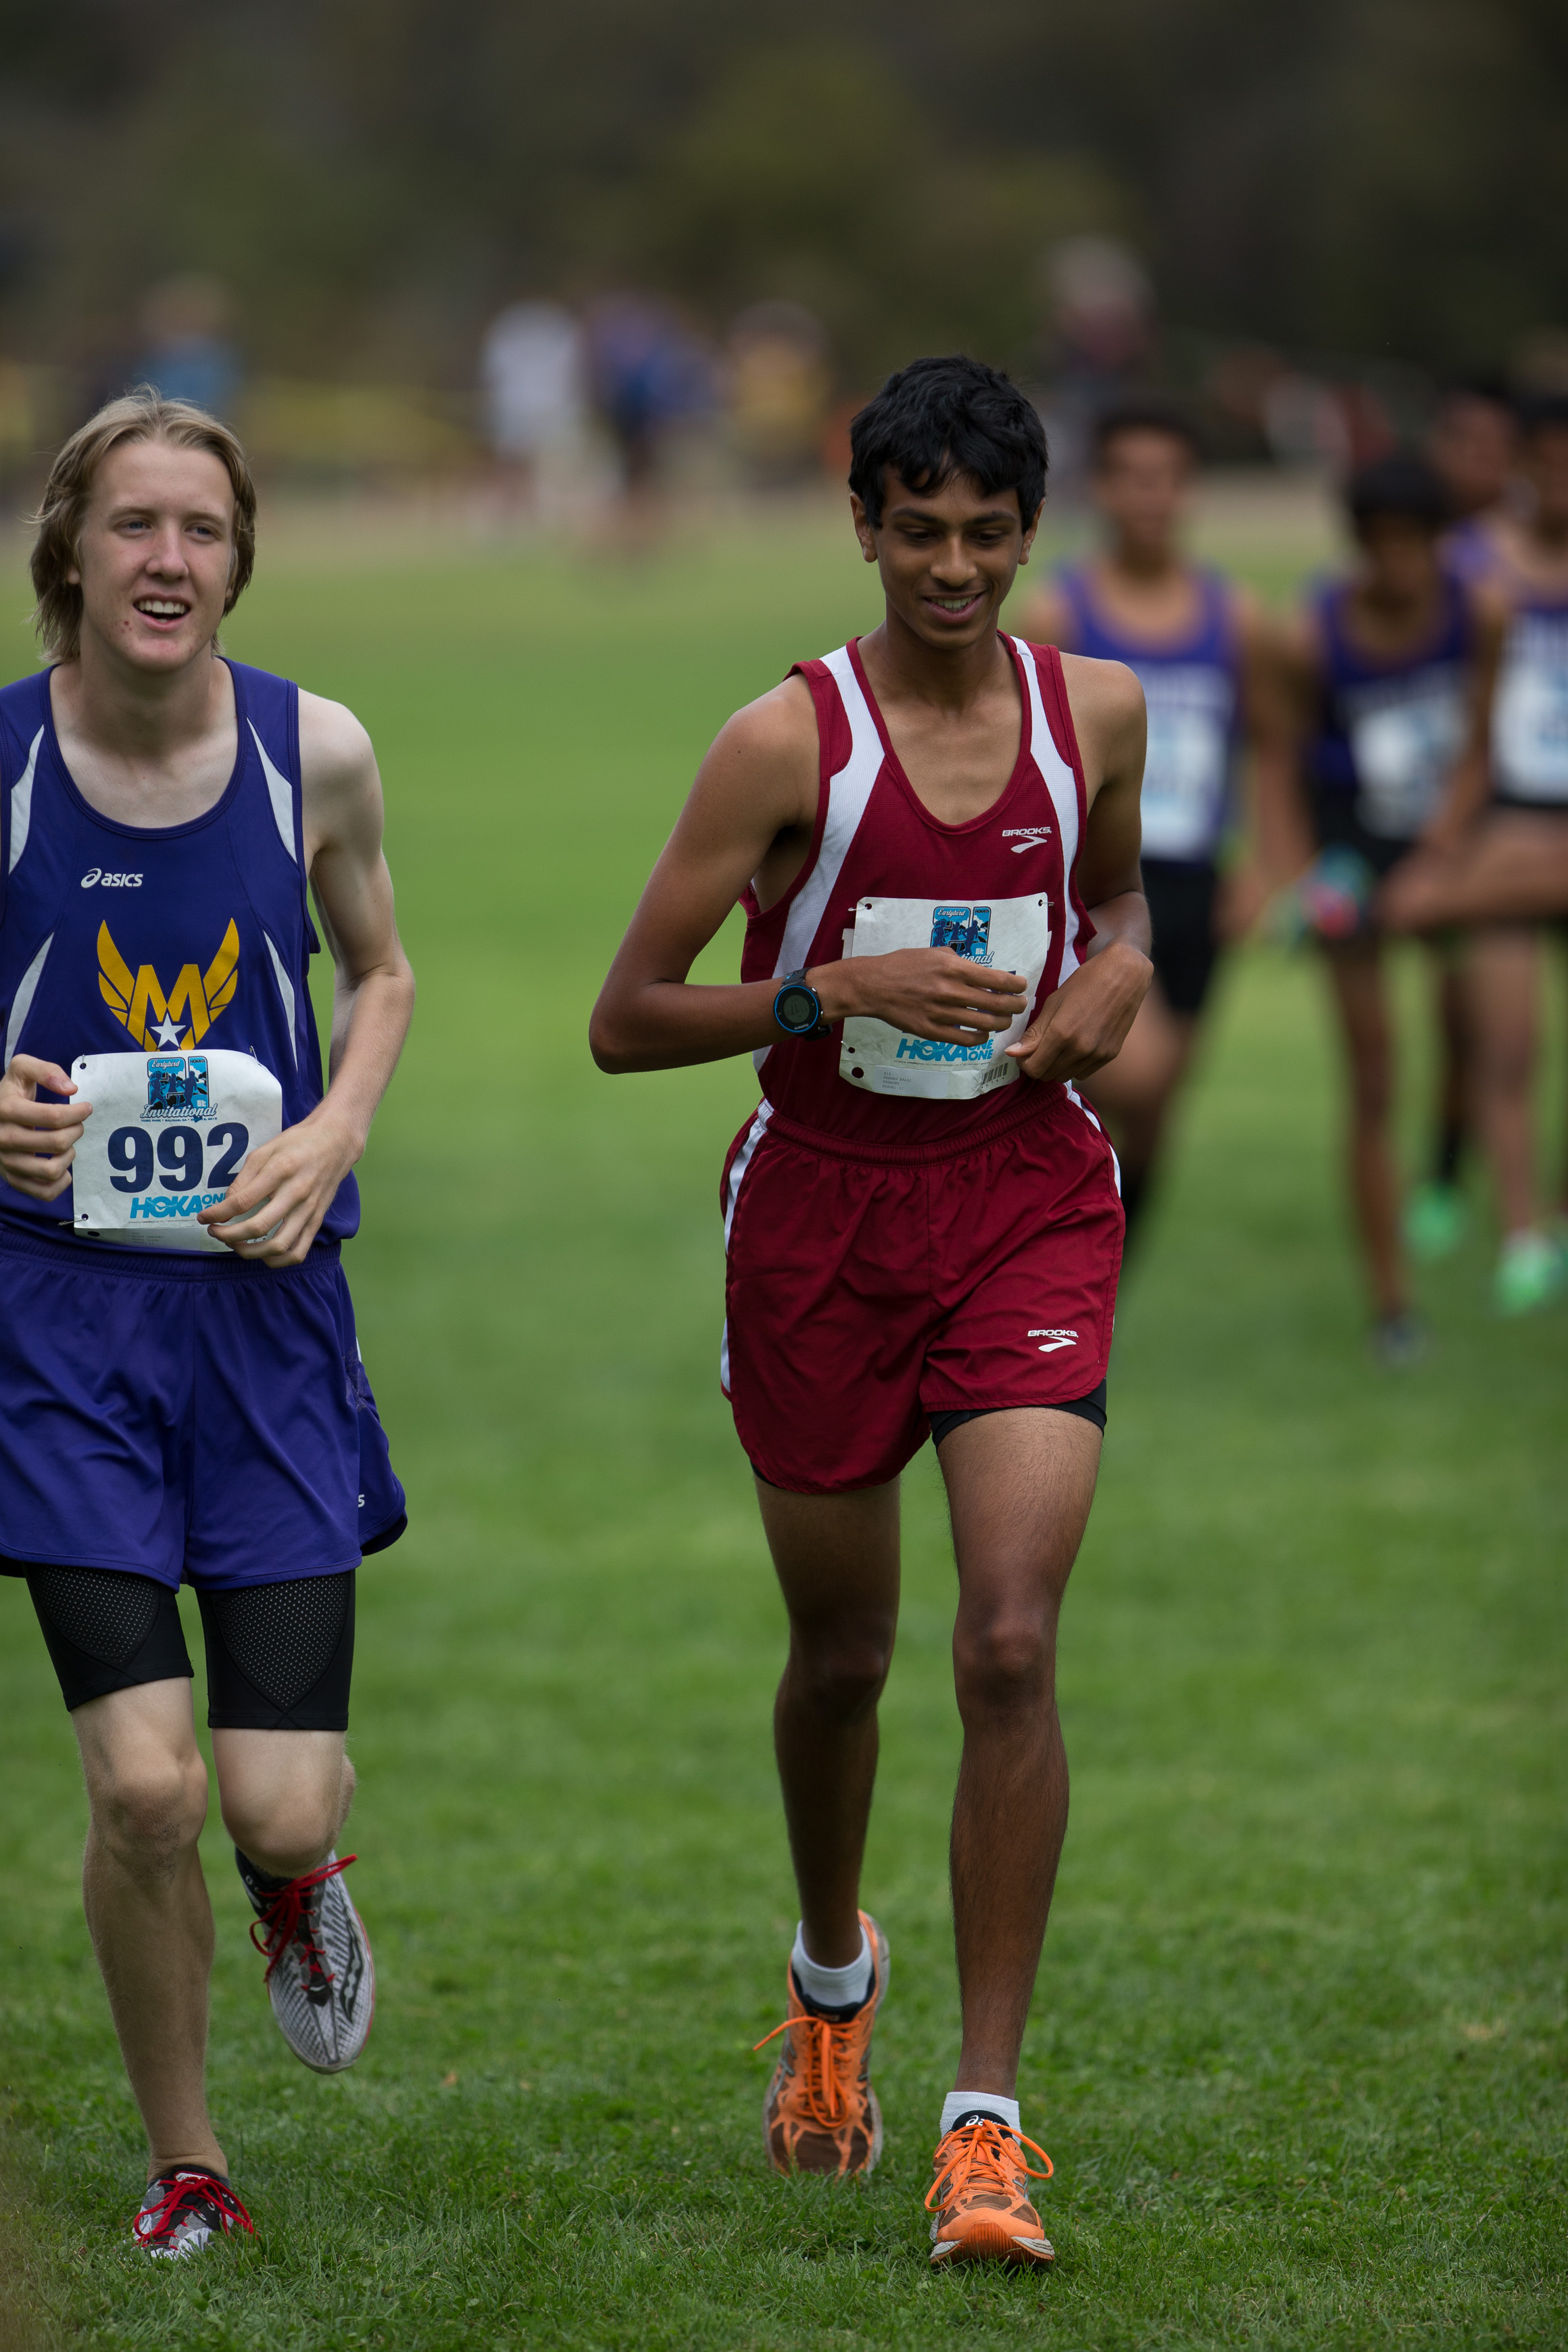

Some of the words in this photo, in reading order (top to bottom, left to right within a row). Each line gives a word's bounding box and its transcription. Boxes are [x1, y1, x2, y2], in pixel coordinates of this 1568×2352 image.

[1002, 827, 1051, 837] BROOKS
[101, 873, 143, 887] asics
[937, 908, 966, 918] Earlybird
[968, 1049, 994, 1060] ONE
[151, 1060, 181, 1070] Earlybird
[140, 1103, 218, 1118] Invitational
[107, 1122, 249, 1194] 992
[130, 1195, 203, 1219] HOKA
